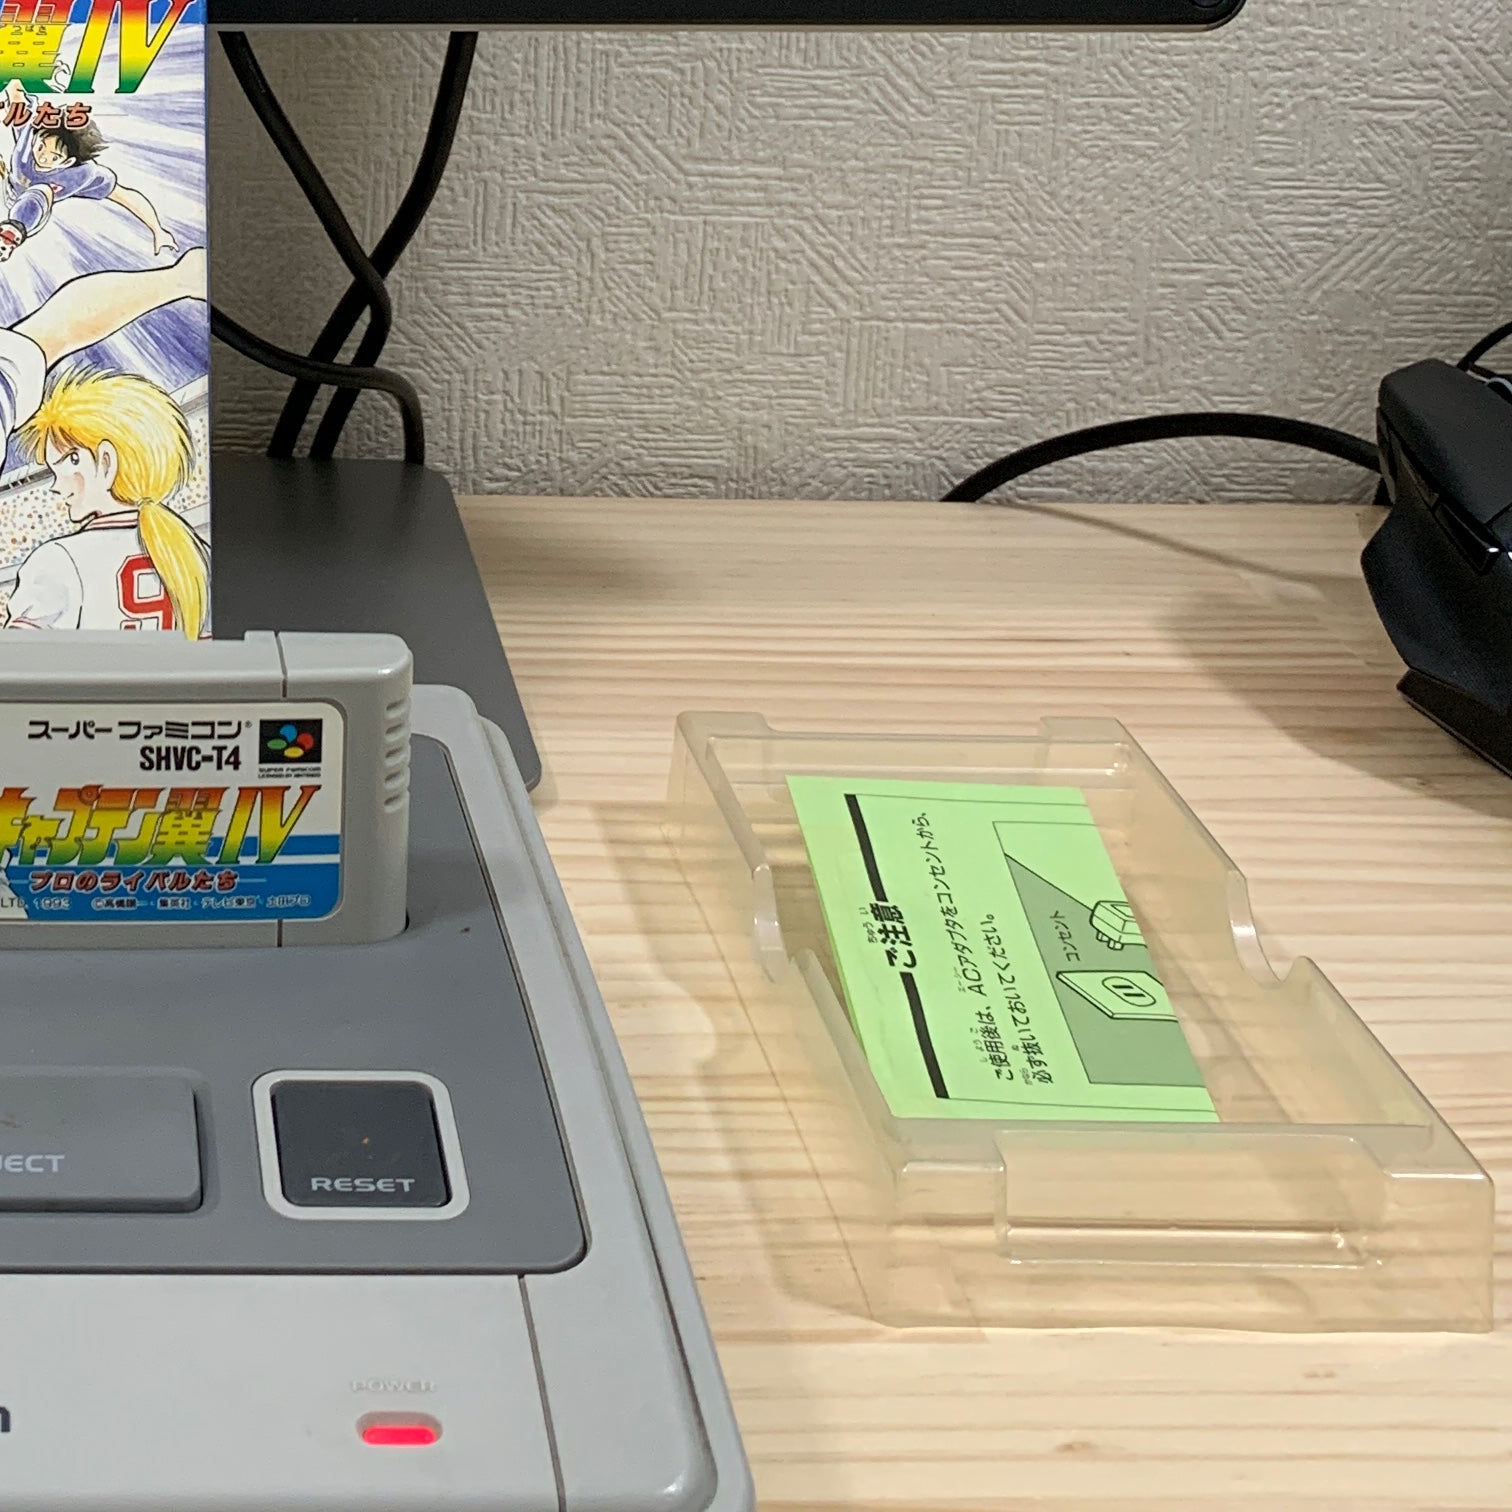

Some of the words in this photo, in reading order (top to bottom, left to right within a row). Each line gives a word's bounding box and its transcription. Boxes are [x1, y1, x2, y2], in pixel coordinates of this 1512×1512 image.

[139, 744, 242, 772] SHVC-T4
[29, 869, 240, 893] プロのライバルたち
[868, 901, 919, 970] ご注意
[1048, 909, 1082, 963] コンセント
[310, 1176, 416, 1194] RESET
[350, 1379, 437, 1394] POWER
